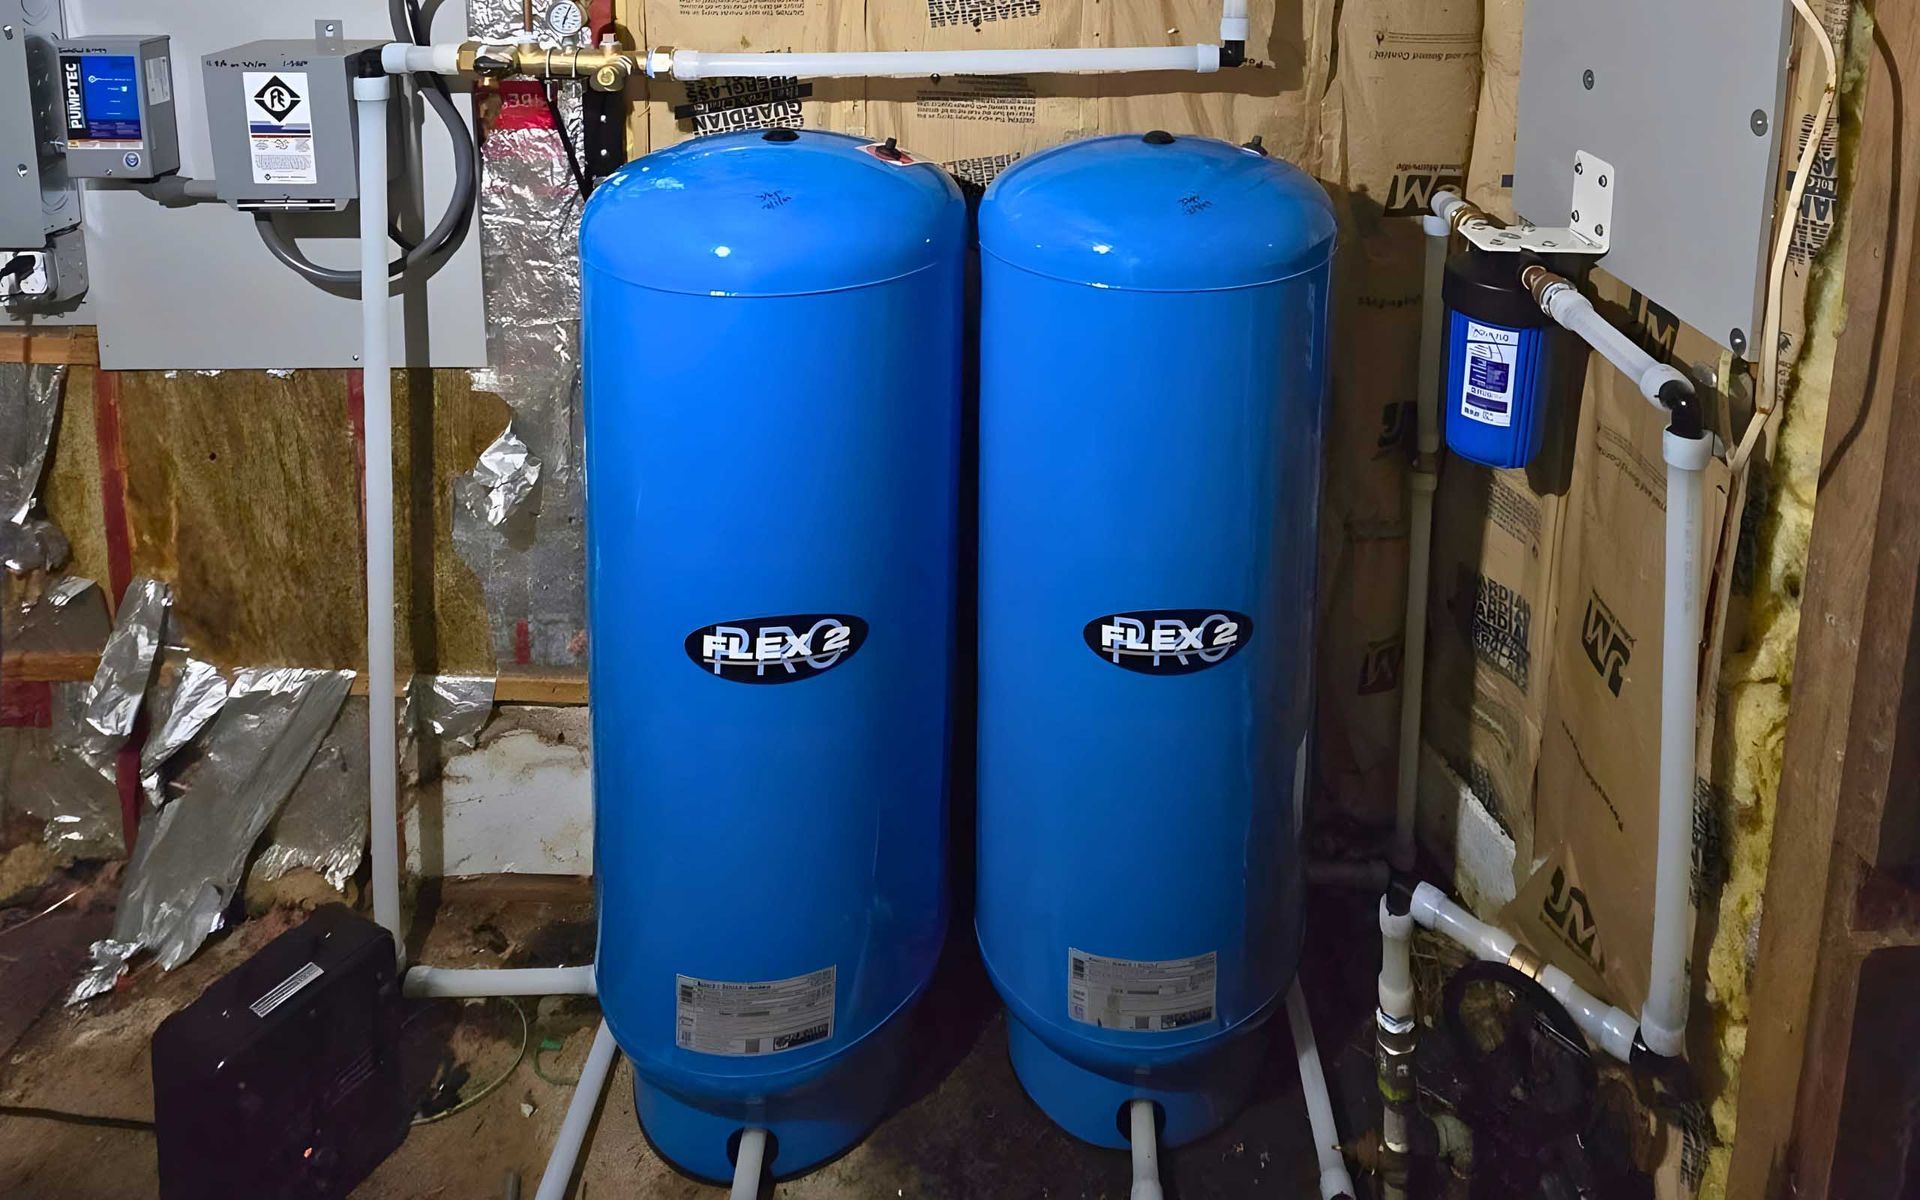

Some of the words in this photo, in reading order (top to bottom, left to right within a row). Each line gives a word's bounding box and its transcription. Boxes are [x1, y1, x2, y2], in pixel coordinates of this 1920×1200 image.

[1374, 50, 1410, 61] Control
[1411, 53, 1444, 62] Sound
[65, 63, 82, 129] PUMPTEC
[691, 99, 802, 132] GUARDIAN
[703, 633, 813, 660] FLEX
[822, 626, 851, 652] 2
[1101, 624, 1204, 651] FLEX
[1212, 622, 1238, 646] 2
